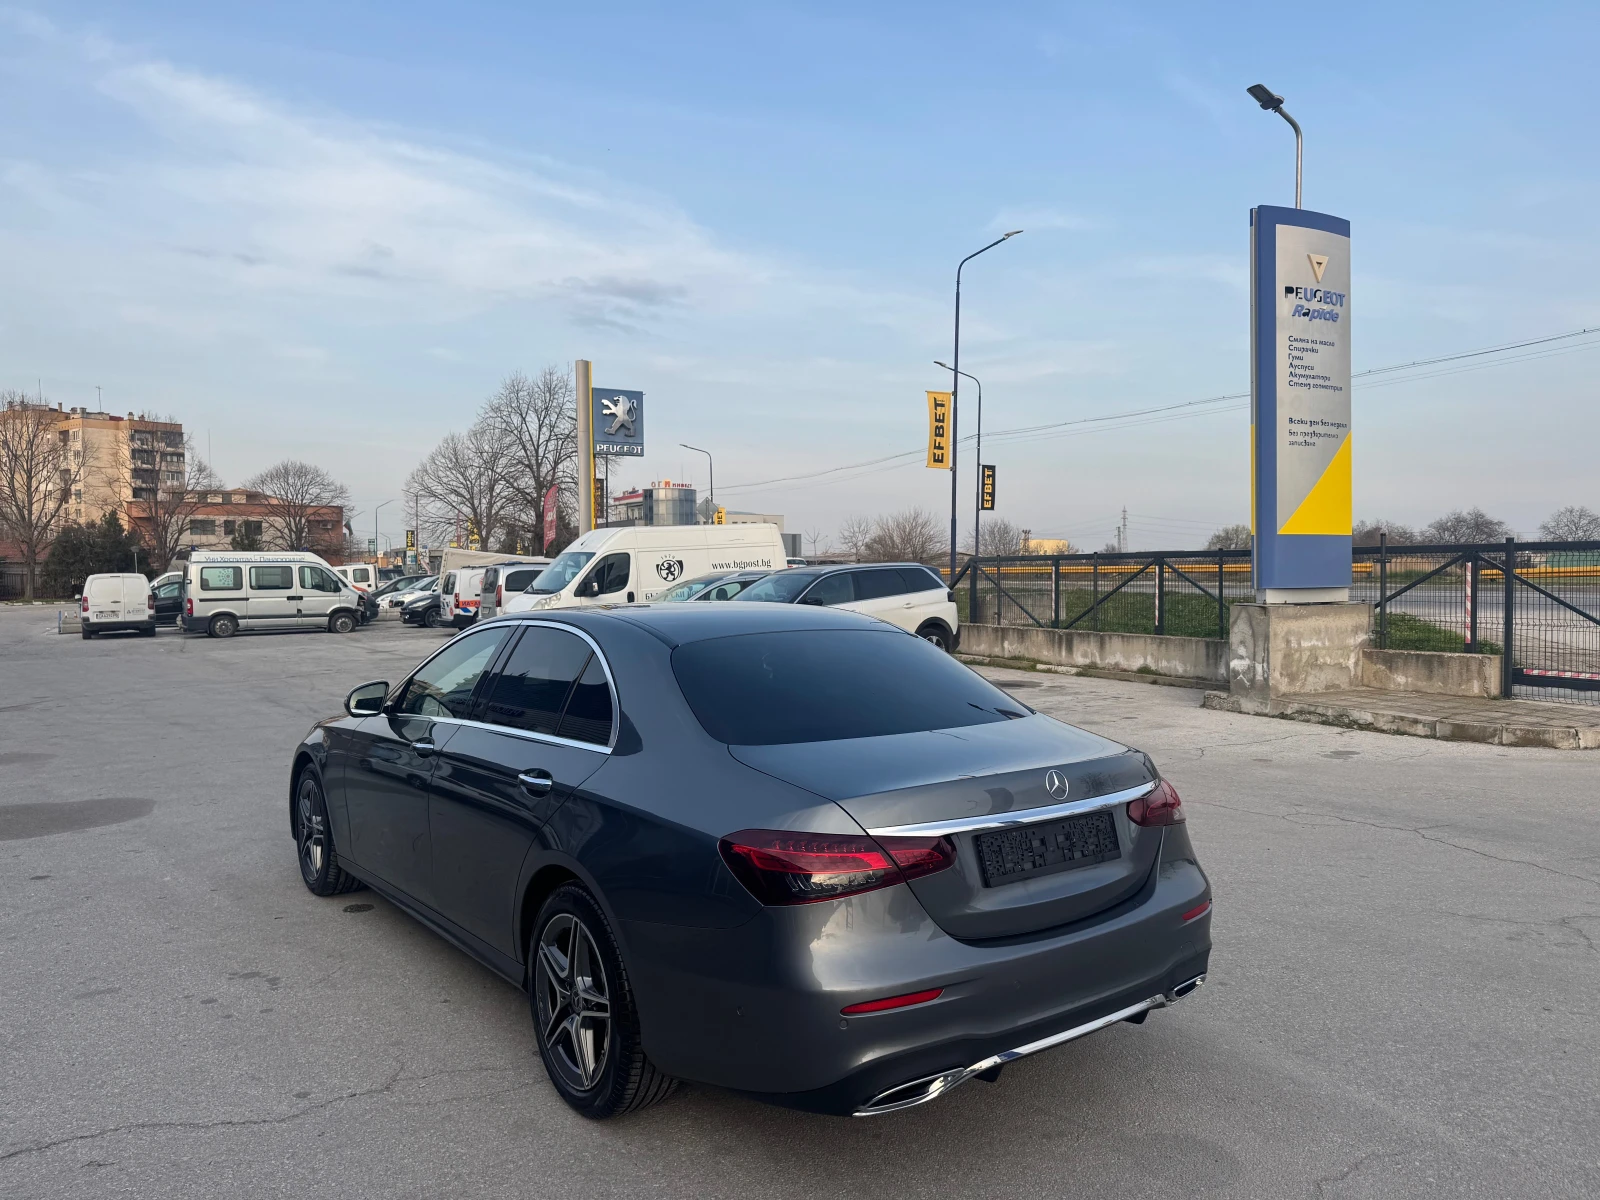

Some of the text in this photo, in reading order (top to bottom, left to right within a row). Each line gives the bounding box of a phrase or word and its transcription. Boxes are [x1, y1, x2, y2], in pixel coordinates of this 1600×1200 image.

[1284, 286, 1346, 307] PEUGEOT
[1292, 304, 1340, 322] Rapide
[1288, 335, 1309, 344] Смяна
[1288, 344, 1319, 354] Спирачки
[1288, 353, 1304, 361] Гуми
[1288, 362, 1315, 371] Ауспуси
[1288, 371, 1331, 382] Акумулатори
[1288, 380, 1311, 390] Стенд
[1288, 417, 1308, 425] Всеки
[933, 397, 945, 464] EFBET
[596, 444, 643, 454] PEUGEOT
[983, 467, 993, 508] EFBET
[711, 558, 772, 570] www.bgpost.bg
